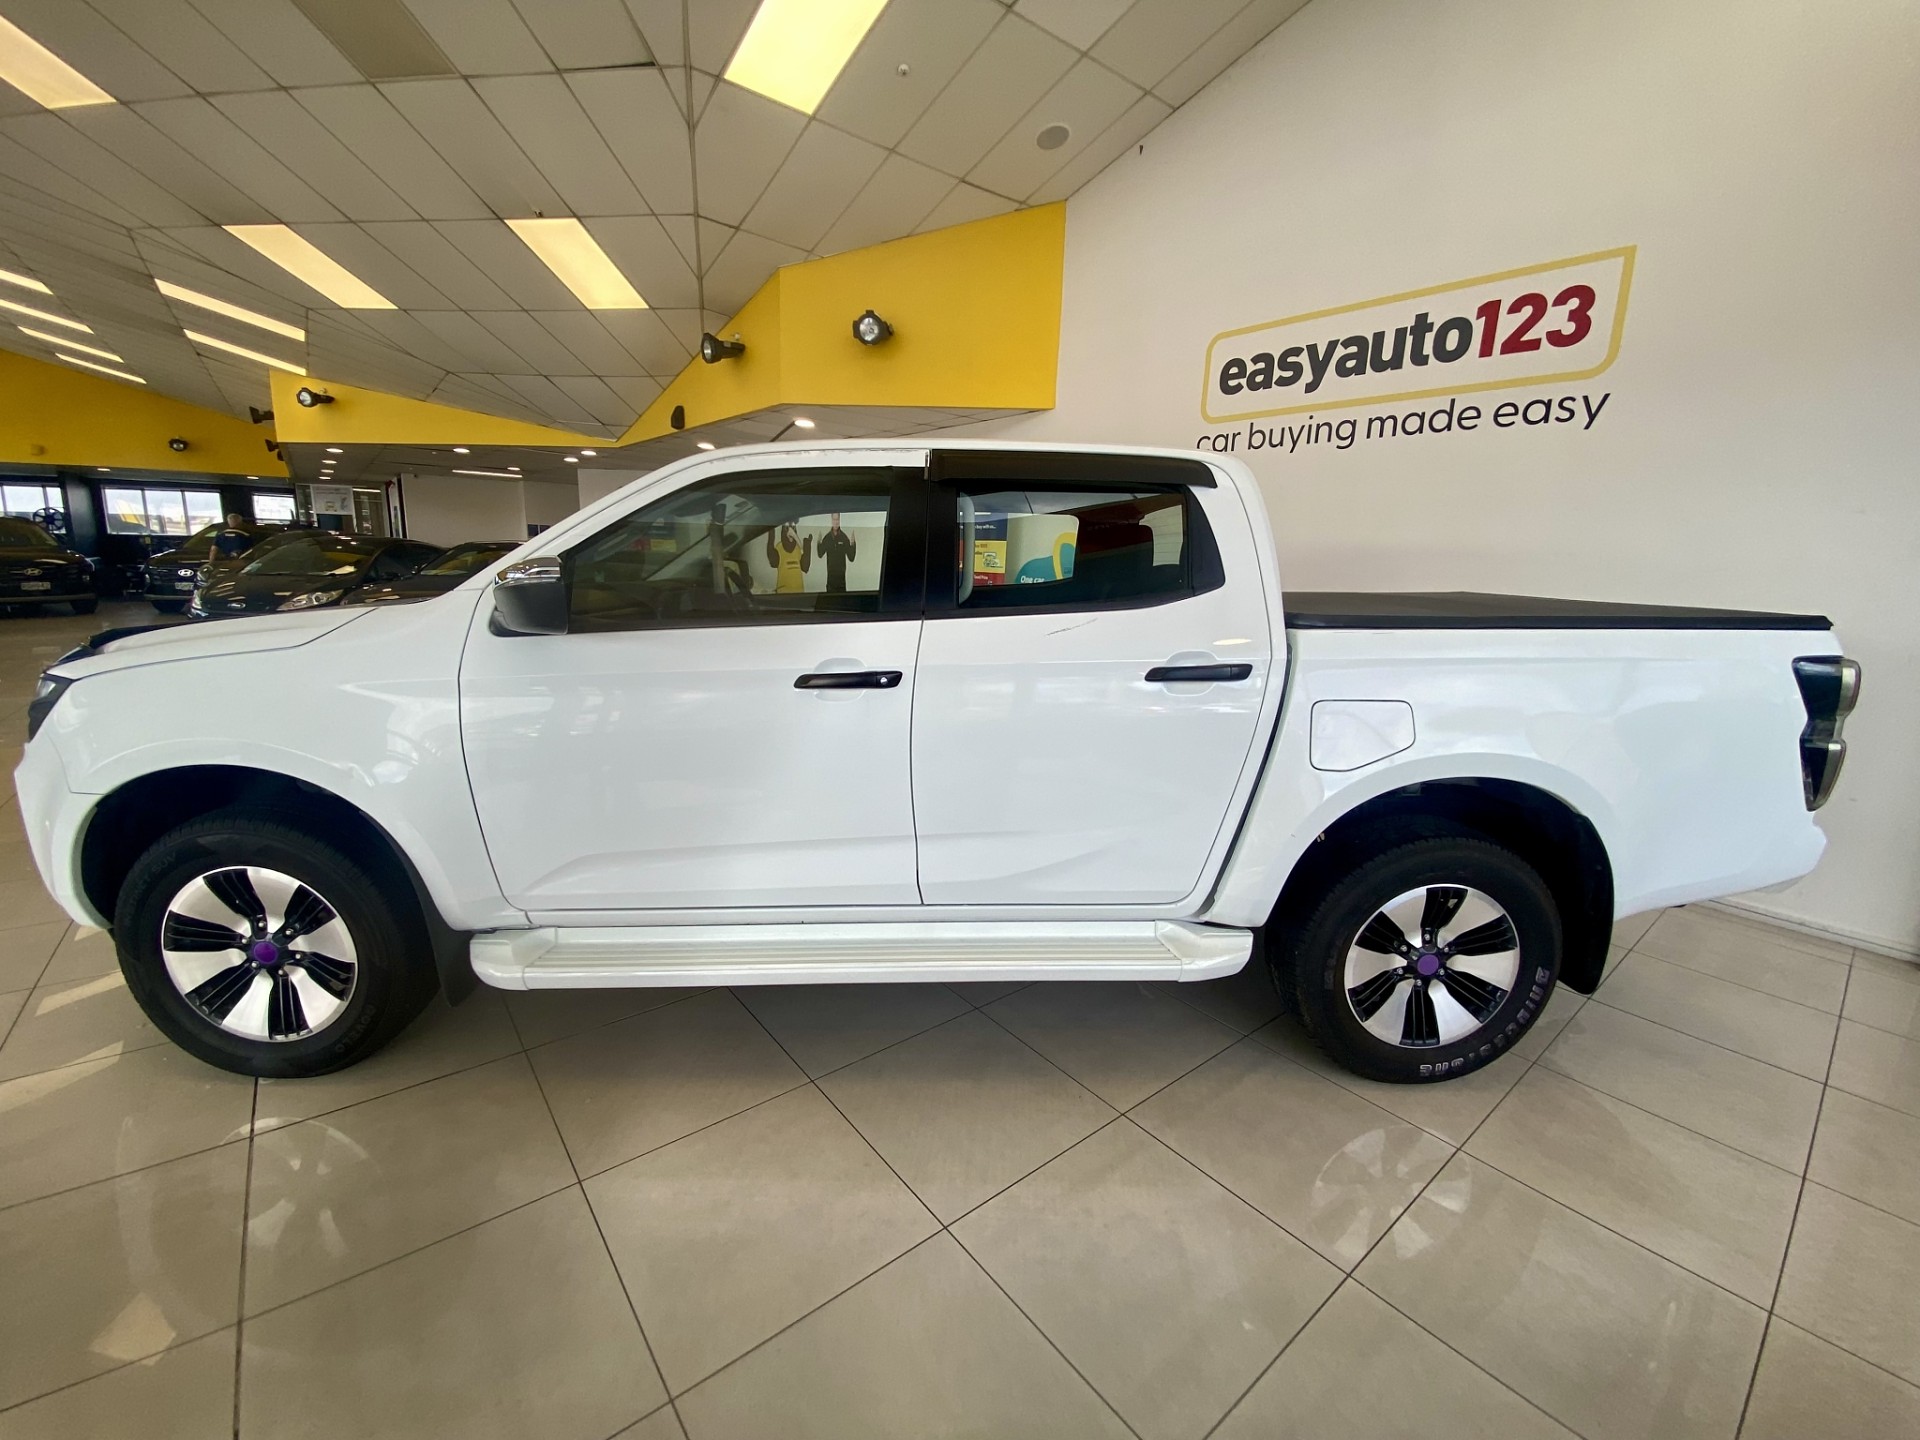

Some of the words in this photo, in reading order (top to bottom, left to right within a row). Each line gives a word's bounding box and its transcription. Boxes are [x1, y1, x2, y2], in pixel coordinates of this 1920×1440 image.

[1219, 284, 1596, 395] easyauto123
[1196, 431, 1242, 453] car
[1247, 415, 1357, 454] buying
[1366, 398, 1482, 439] made
[1493, 392, 1611, 430] easy
